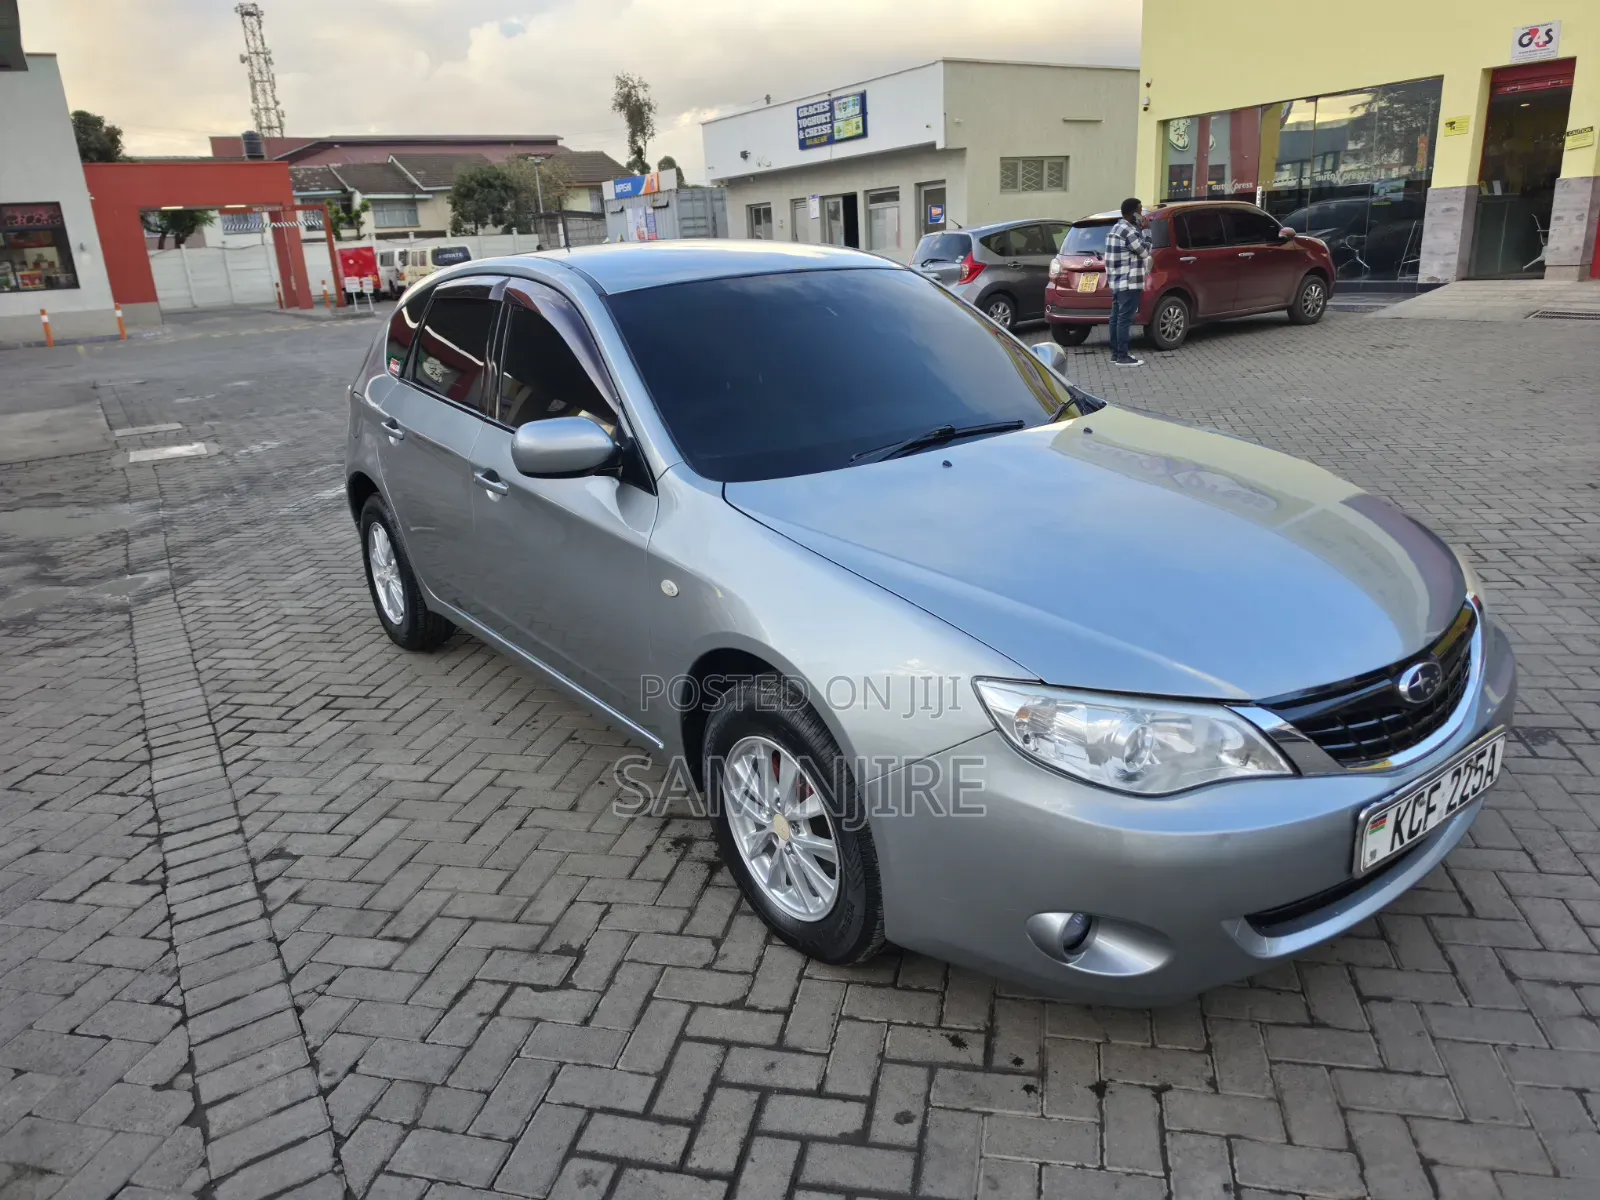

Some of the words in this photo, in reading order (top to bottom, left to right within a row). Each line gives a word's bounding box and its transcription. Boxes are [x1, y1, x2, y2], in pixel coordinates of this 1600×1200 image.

[1518, 28, 1553, 48] G4S
[799, 101, 830, 117] GRACIES
[798, 113, 831, 128] YOGHURT
[799, 130, 805, 139] &
[805, 124, 832, 137] CHEESE
[615, 183, 632, 193] MPISHI
[1212, 179, 1253, 194] autoXpress
[1390, 781, 1441, 852] KCF
[1445, 743, 1497, 815] 225A
